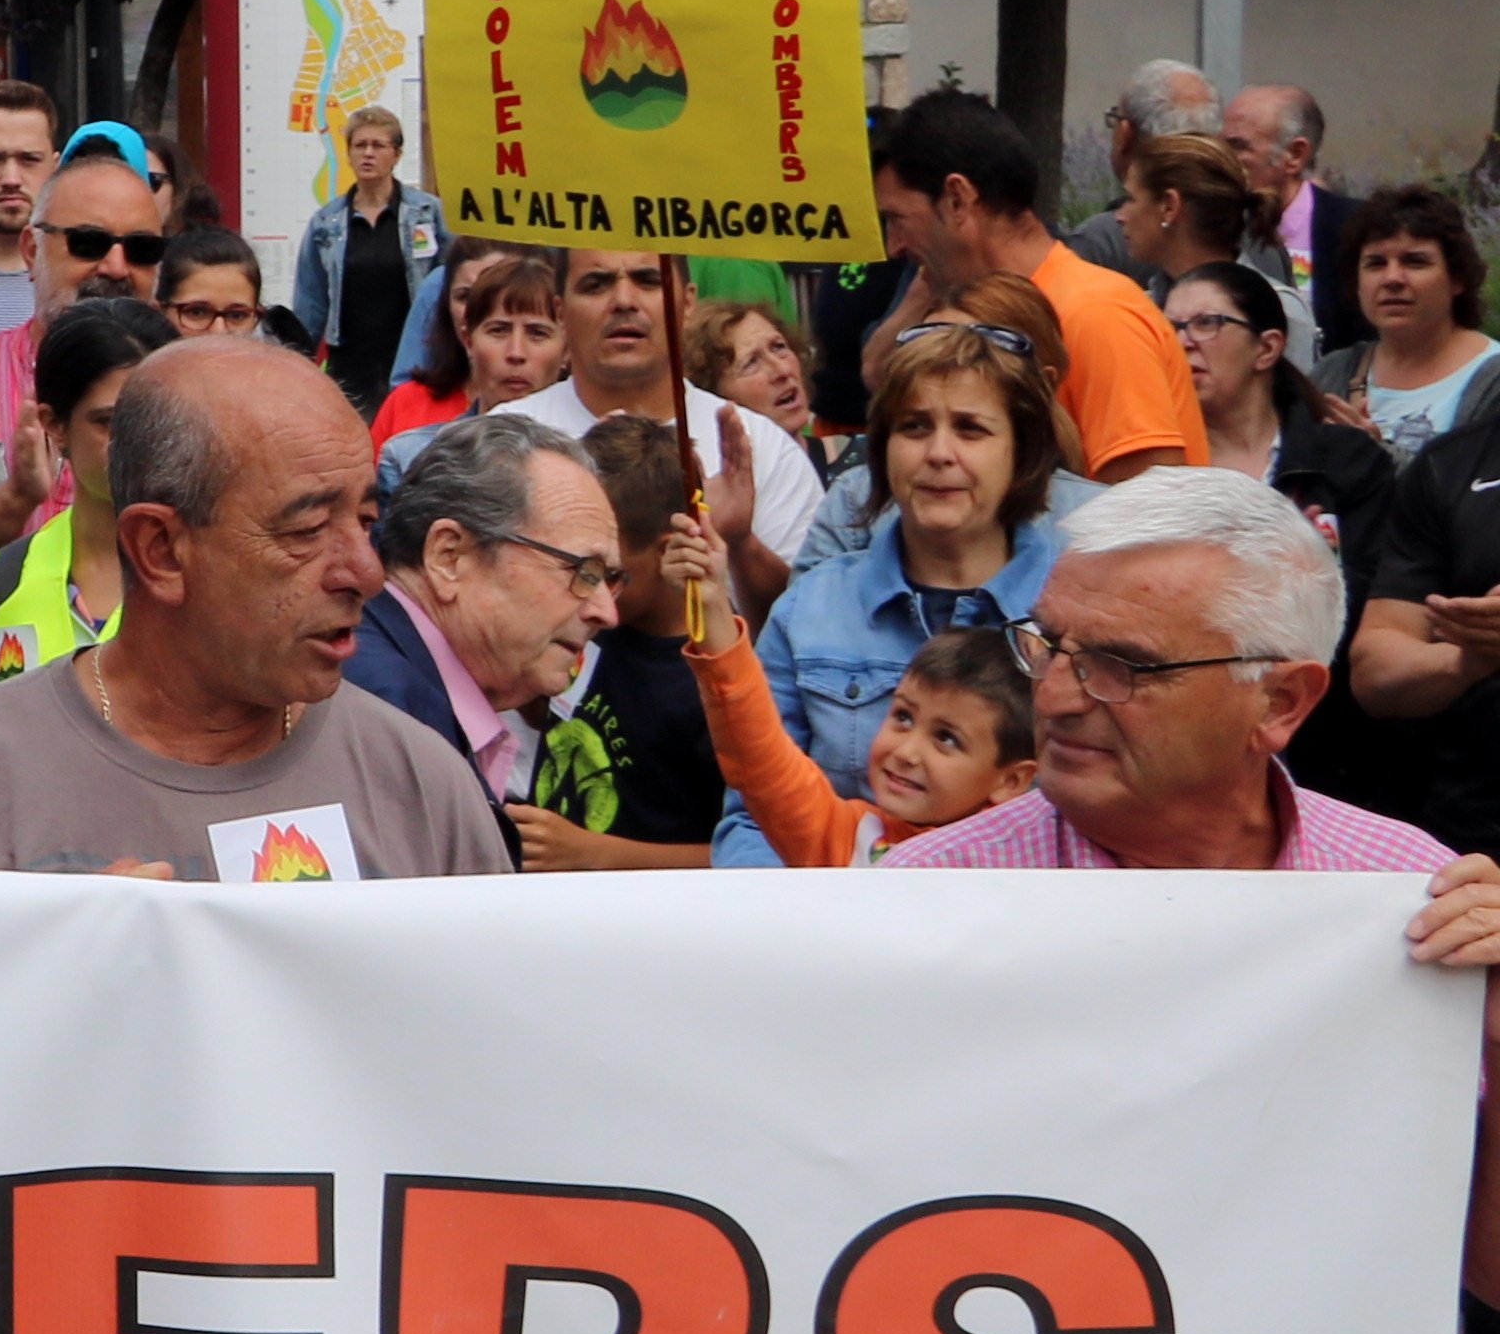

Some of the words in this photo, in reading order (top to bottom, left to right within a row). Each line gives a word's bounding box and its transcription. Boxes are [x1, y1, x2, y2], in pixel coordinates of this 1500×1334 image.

[460, 187, 485, 223] A
[492, 187, 612, 233] L'ALTA
[633, 195, 850, 242] RIBAGORÇA
